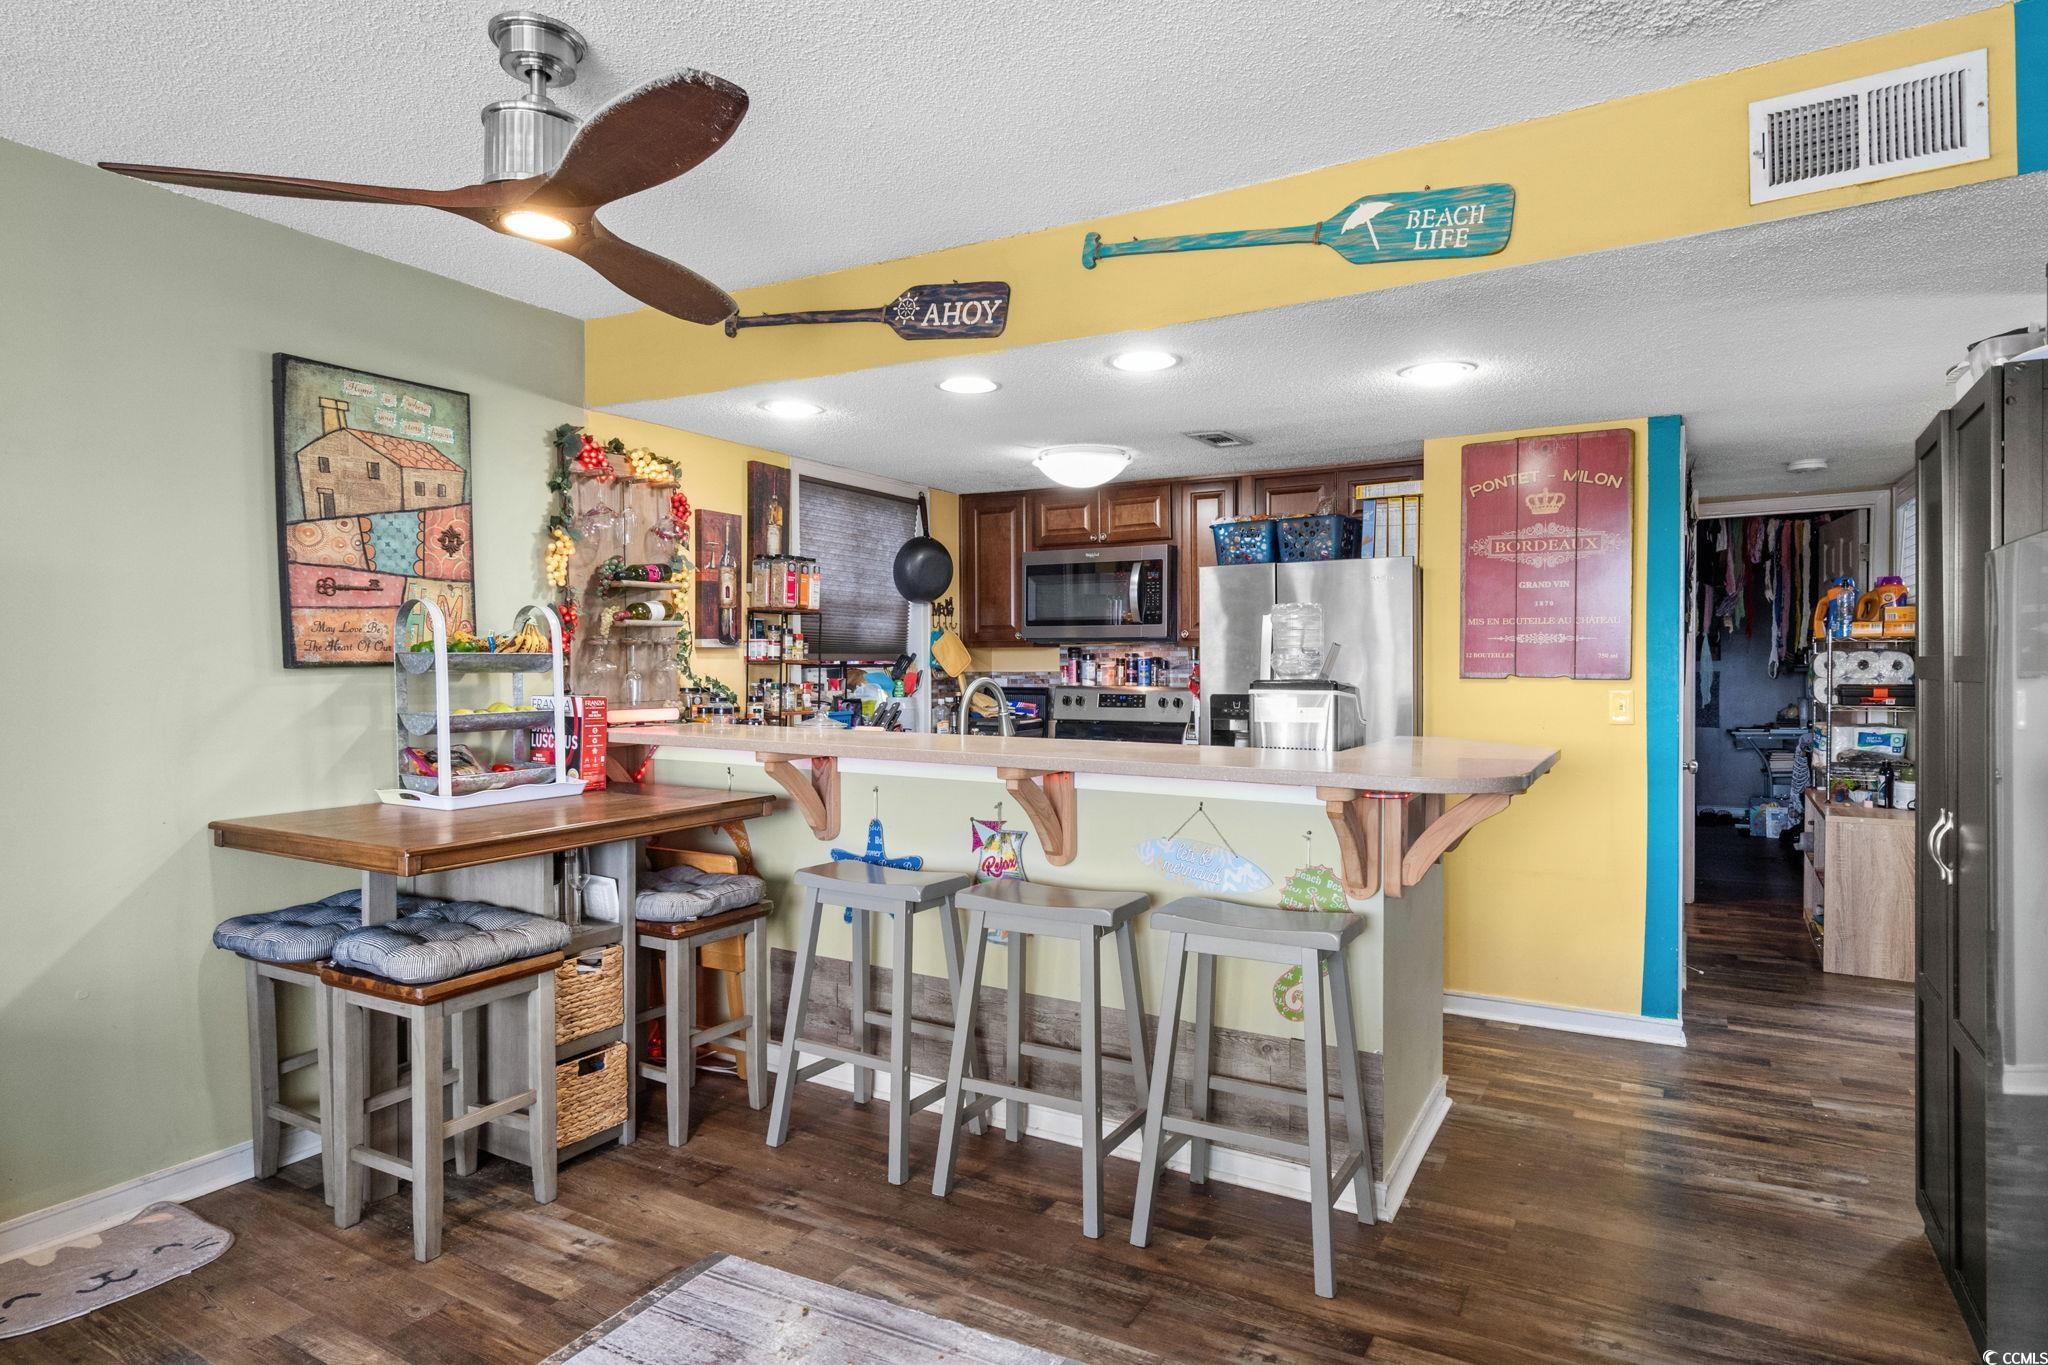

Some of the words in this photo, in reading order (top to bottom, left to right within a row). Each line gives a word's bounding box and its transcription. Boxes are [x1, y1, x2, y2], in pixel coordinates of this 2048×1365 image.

[1405, 204, 1486, 229] BEACH
[1413, 227, 1470, 250] LIFE
[920, 299, 1003, 327] AHOY
[345, 382, 373, 395] Home
[405, 399, 428, 412] where
[1469, 470, 1541, 498] PONTET
[1562, 468, 1624, 489] MILON
[1494, 537, 1599, 553] BORDEAUX
[1518, 580, 1552, 589] GRAND
[1553, 580, 1570, 588] VIN
[310, 620, 336, 634] May
[338, 620, 363, 634] Love
[364, 621, 381, 634] Be
[1467, 617, 1485, 626] MIS
[1486, 617, 1500, 625] EN
[1502, 616, 1557, 625] BOUTEILLE
[1557, 616, 1572, 624] AU
[303, 639, 323, 652] The
[324, 639, 353, 651] Heart
[357, 639, 372, 652] Of
[374, 640, 392, 652] Our
[532, 697, 571, 712] FRANA
[531, 733, 578, 750] LUSCUS
[981, 855, 1018, 878] Relax
